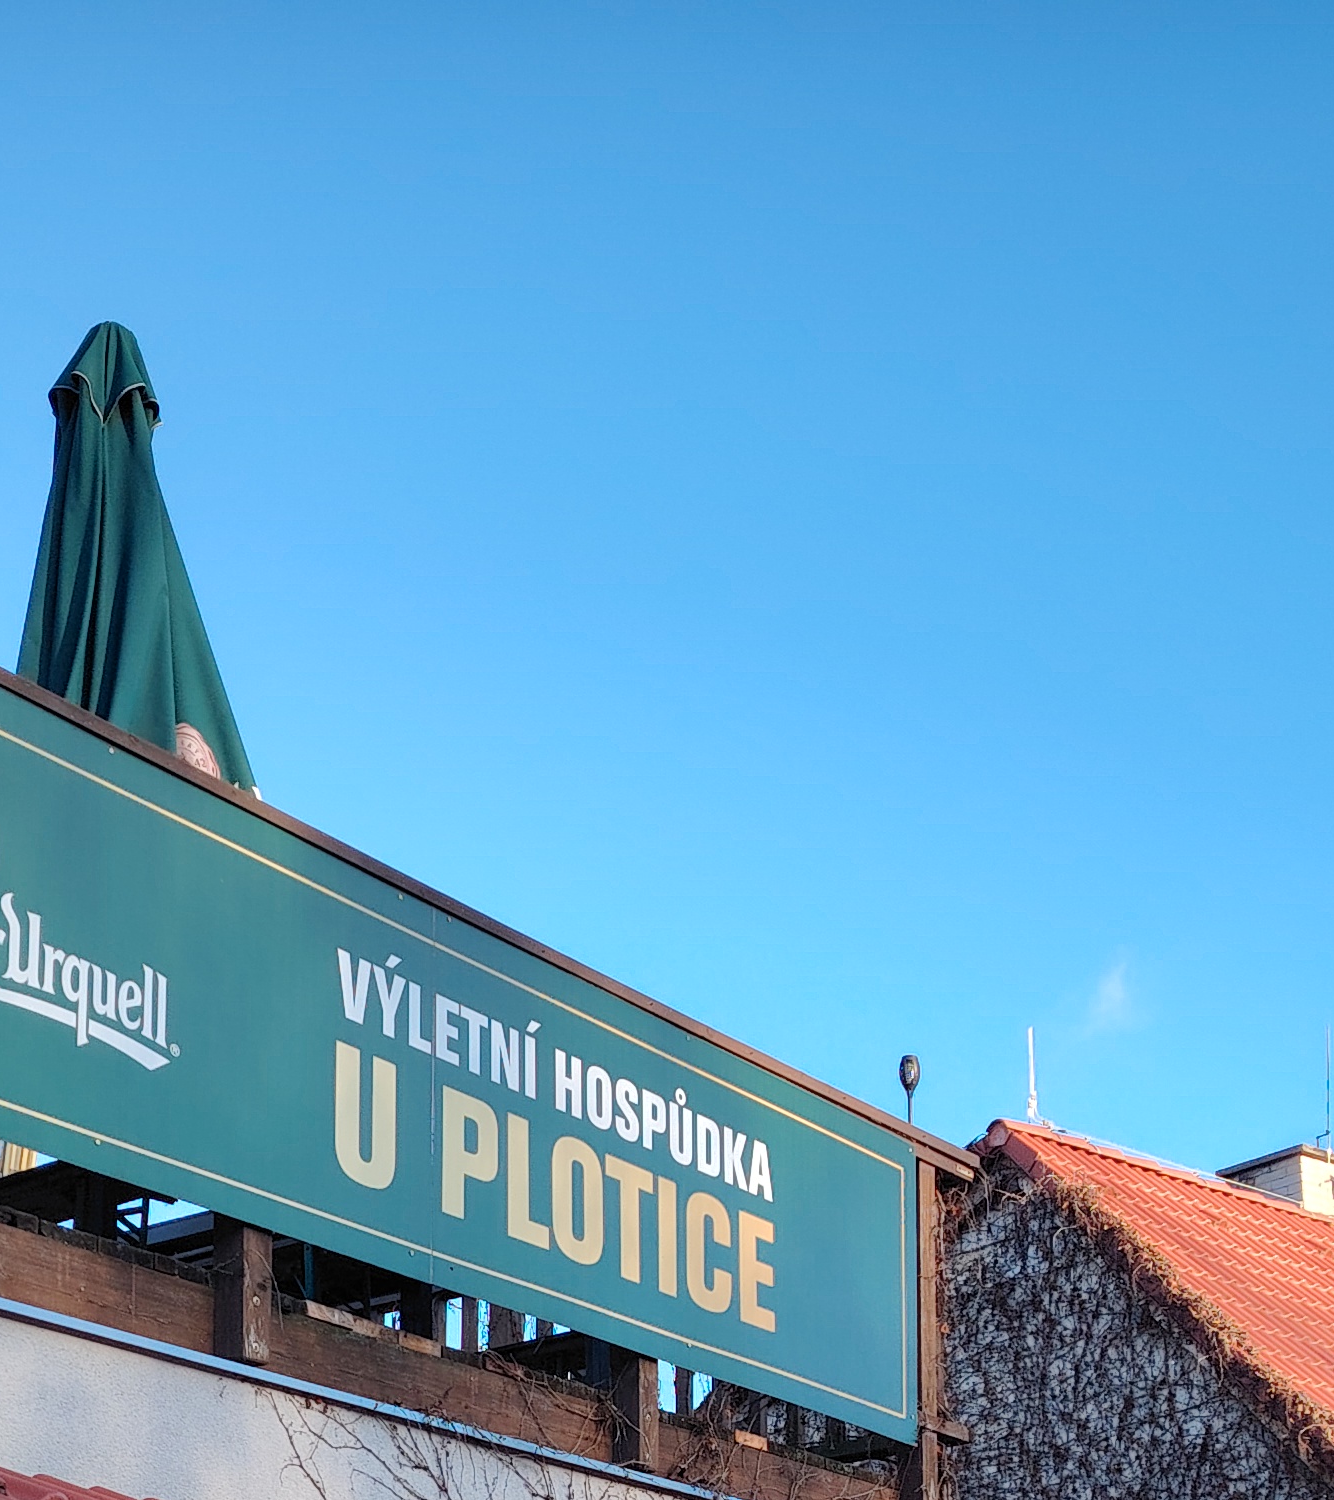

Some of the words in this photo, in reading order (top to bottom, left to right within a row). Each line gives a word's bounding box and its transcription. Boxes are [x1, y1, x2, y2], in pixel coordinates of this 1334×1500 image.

[0, 891, 168, 1048] Urquell
[335, 947, 542, 1100] VÝLETNÍ
[553, 1047, 774, 1202] HOSPŮDKA
[333, 1039, 397, 1190] U
[441, 1085, 776, 1333] PLOTICE
